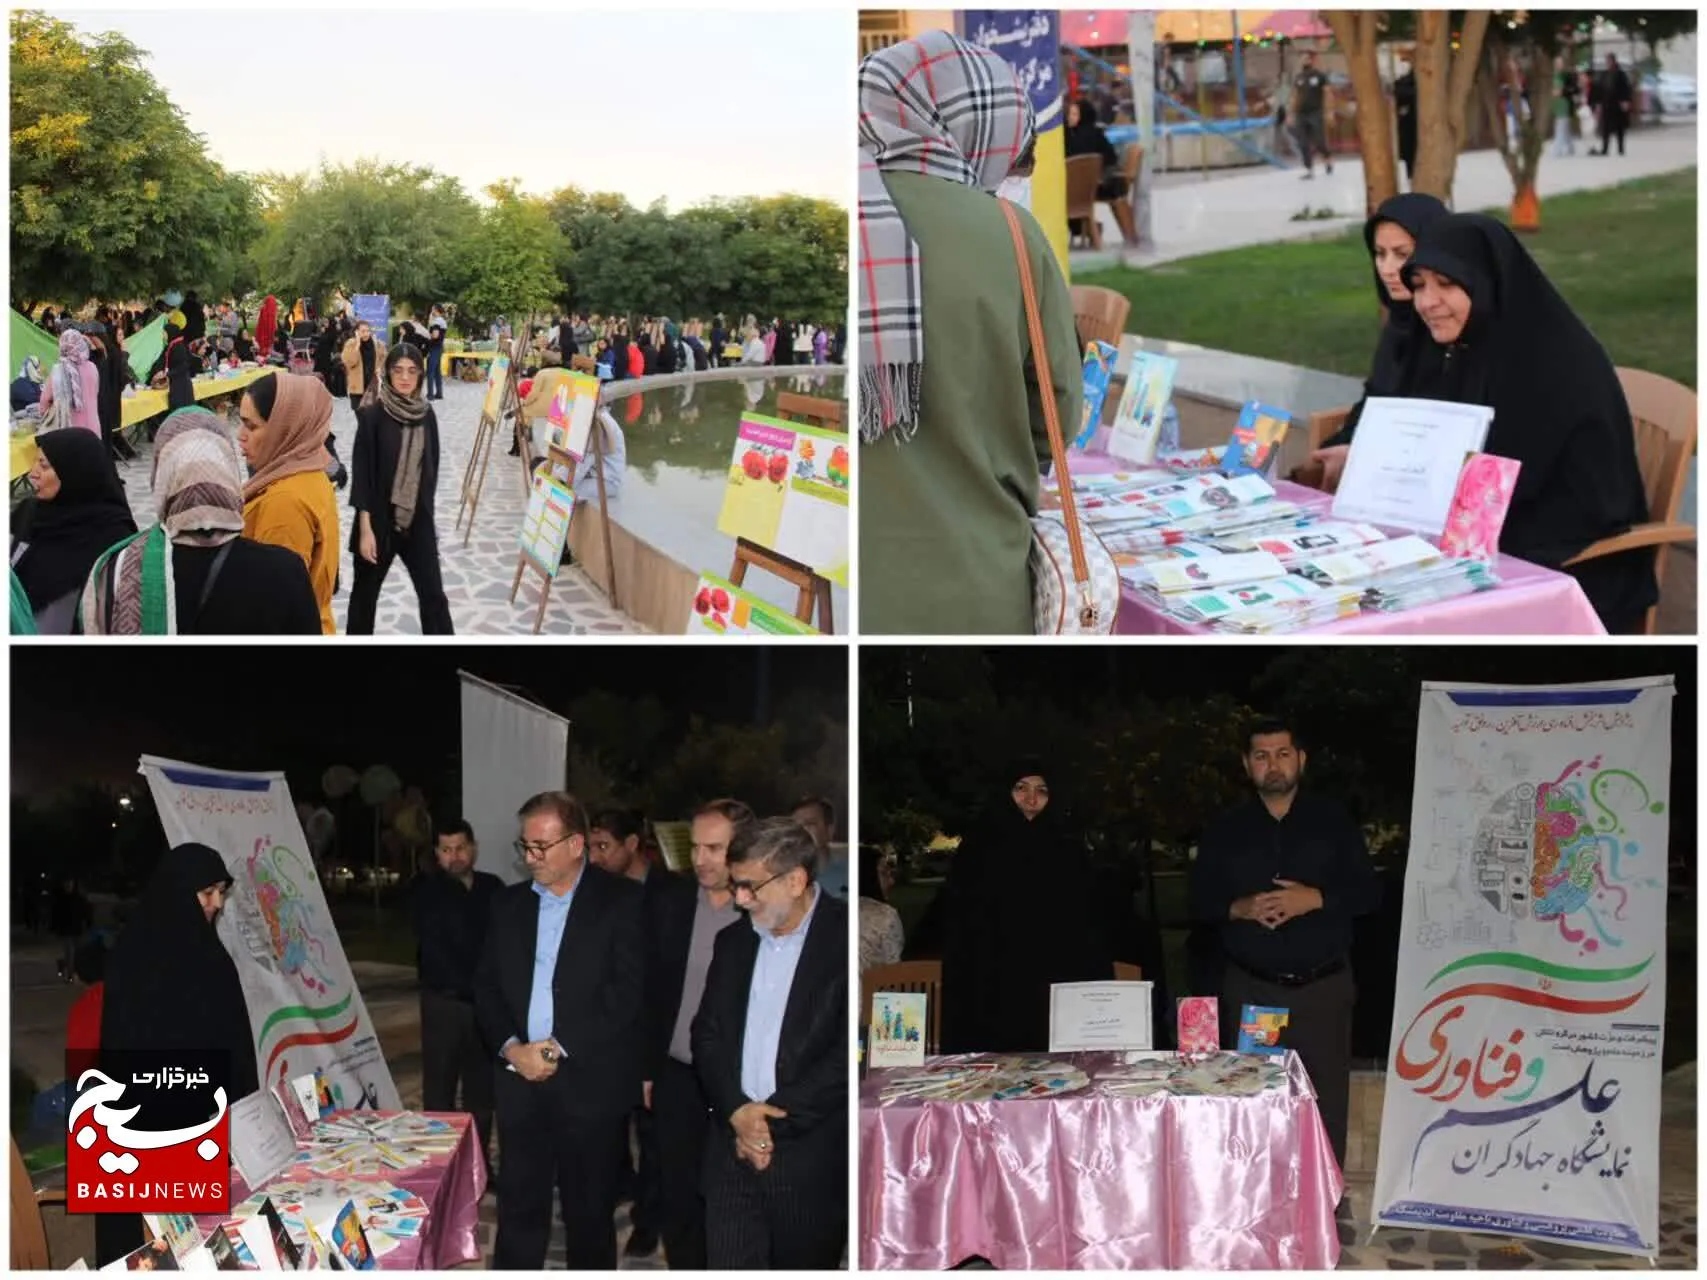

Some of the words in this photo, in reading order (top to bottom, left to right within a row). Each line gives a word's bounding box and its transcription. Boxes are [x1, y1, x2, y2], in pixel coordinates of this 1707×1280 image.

[1395, 1004, 1525, 1102] فناوری
[1504, 1057, 1545, 1102] و
[1557, 1119, 1632, 1179] نمایشگاه
